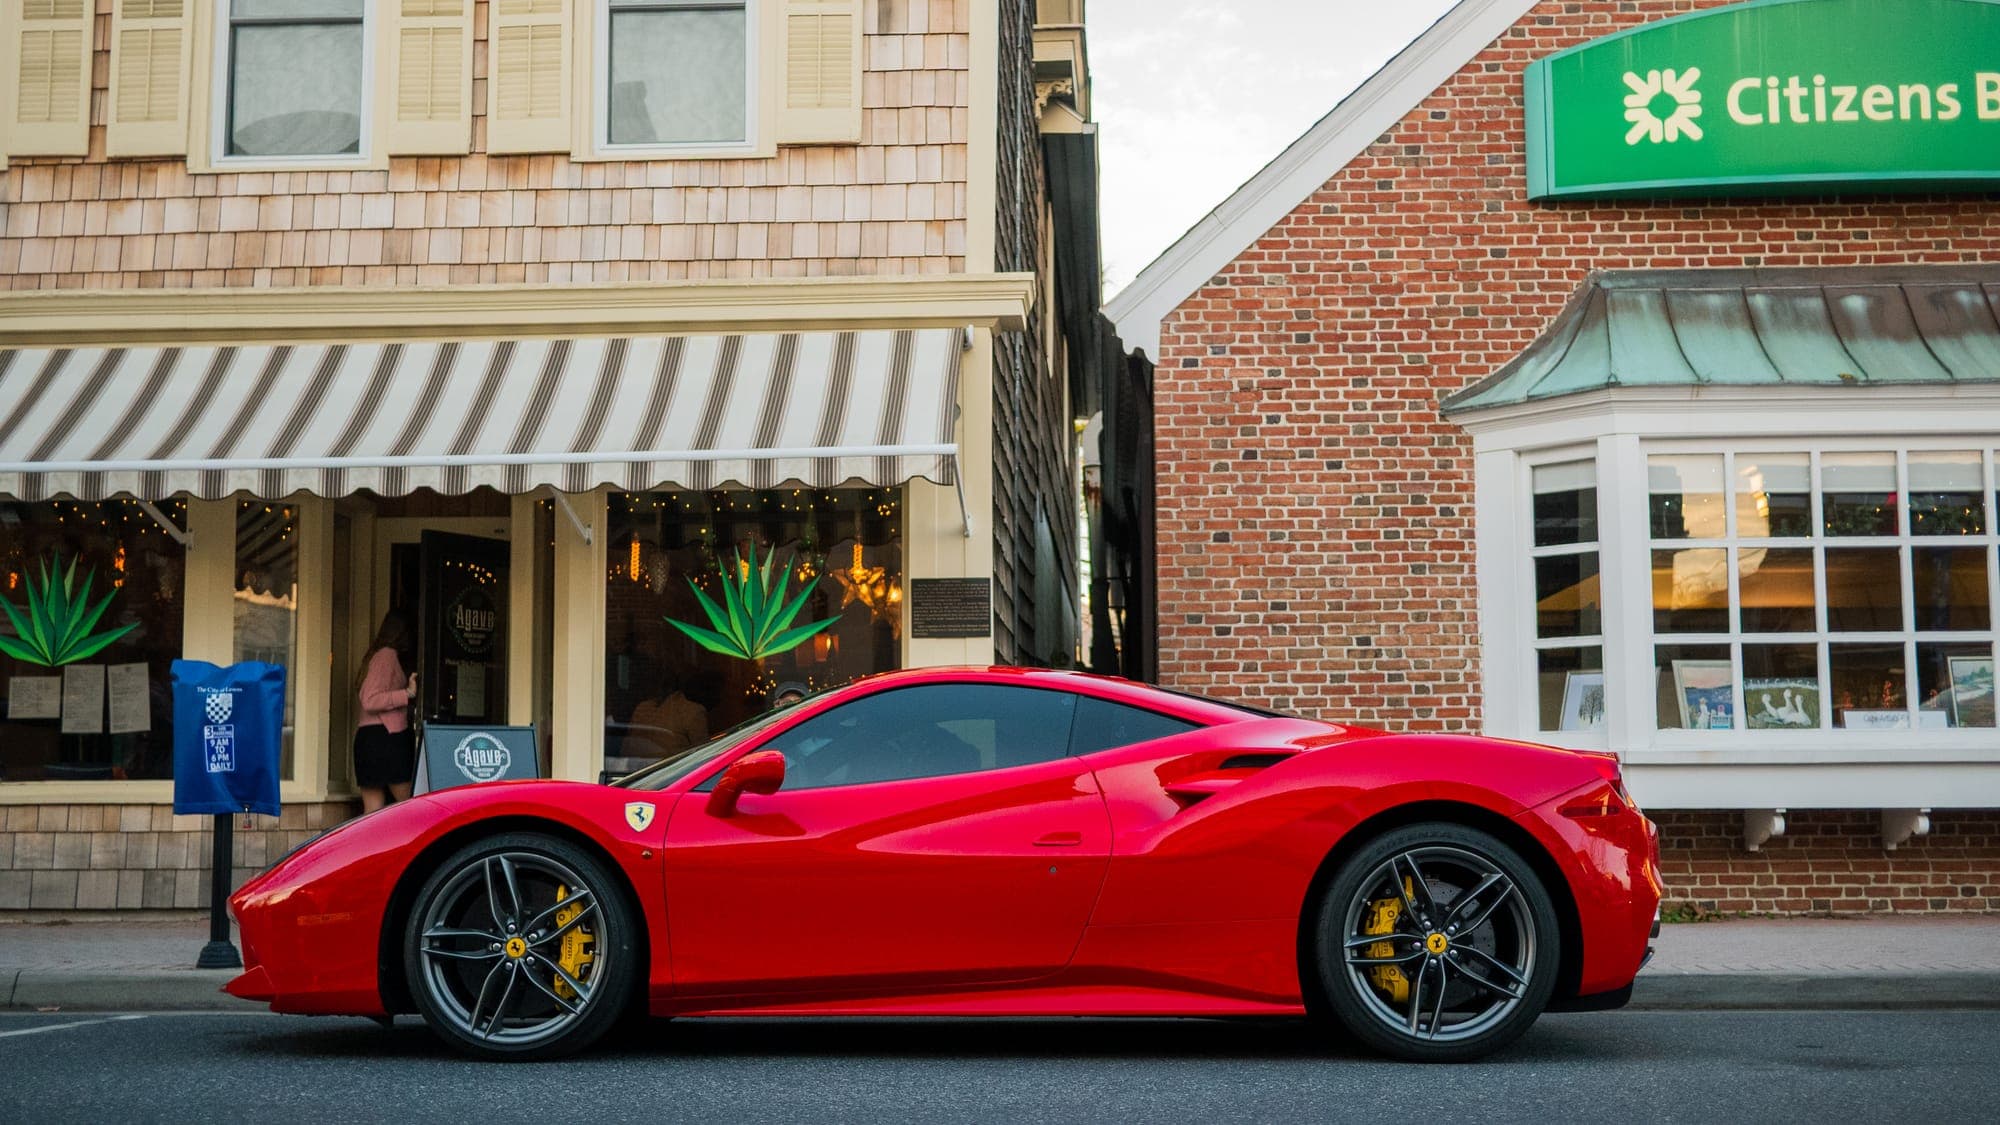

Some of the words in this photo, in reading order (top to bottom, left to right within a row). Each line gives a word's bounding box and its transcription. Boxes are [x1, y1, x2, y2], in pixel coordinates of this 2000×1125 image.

[1727, 74, 1962, 126] Citizens
[1976, 72, 2000, 119] B
[456, 604, 495, 632] Agave
[206, 726, 213, 737] 3
[210, 739, 216, 747] 9
[215, 746, 225, 754] TO
[217, 753, 229, 761] PM
[465, 746, 501, 767] Agave
[210, 762, 231, 770] DAILY
